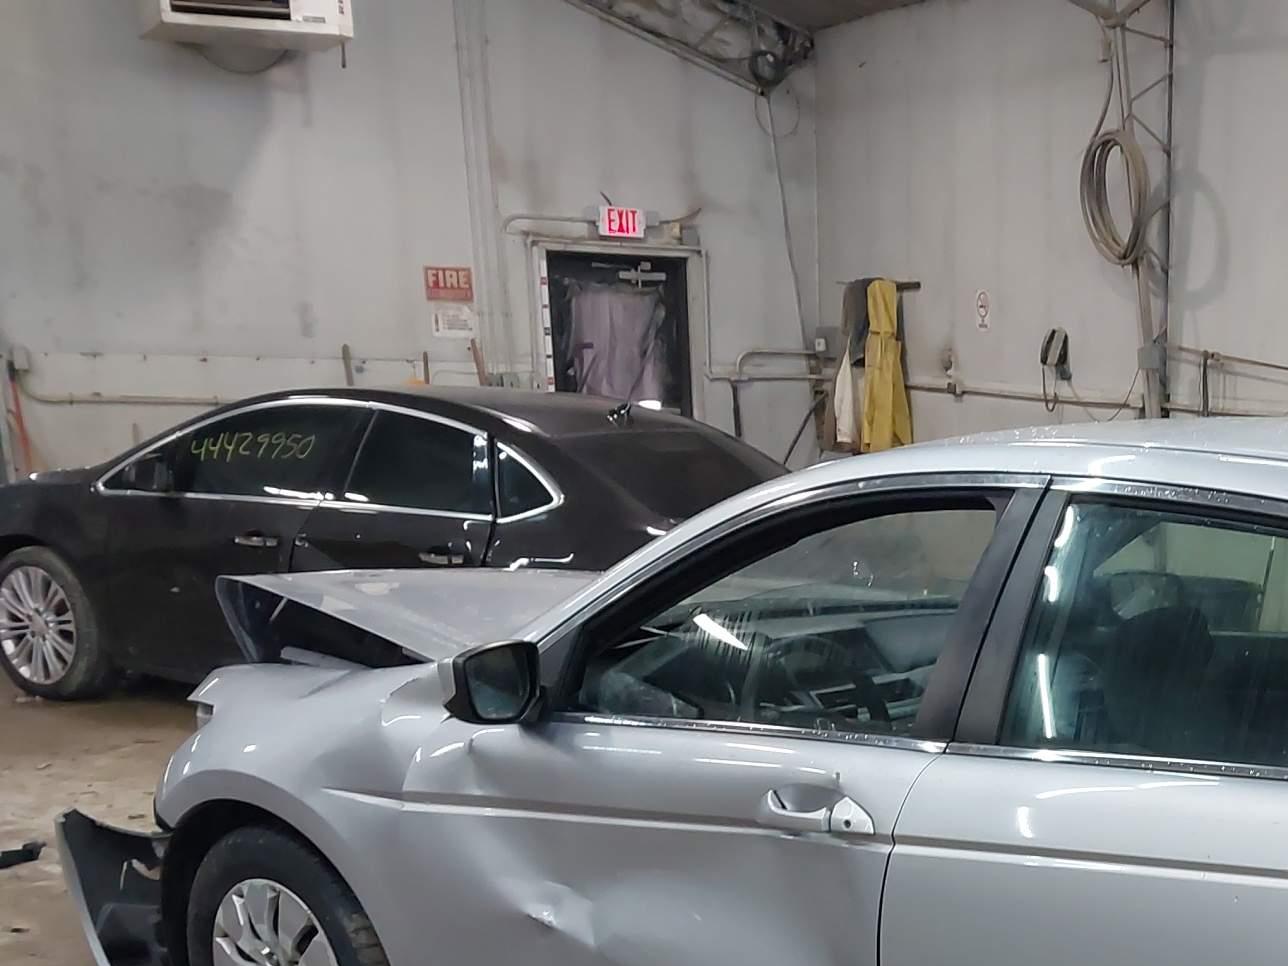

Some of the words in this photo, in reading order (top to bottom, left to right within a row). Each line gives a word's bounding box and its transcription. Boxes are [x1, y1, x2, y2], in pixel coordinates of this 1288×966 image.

[607, 208, 637, 234] EXIT
[427, 269, 470, 288] FIRE
[191, 432, 316, 462] 44429950
